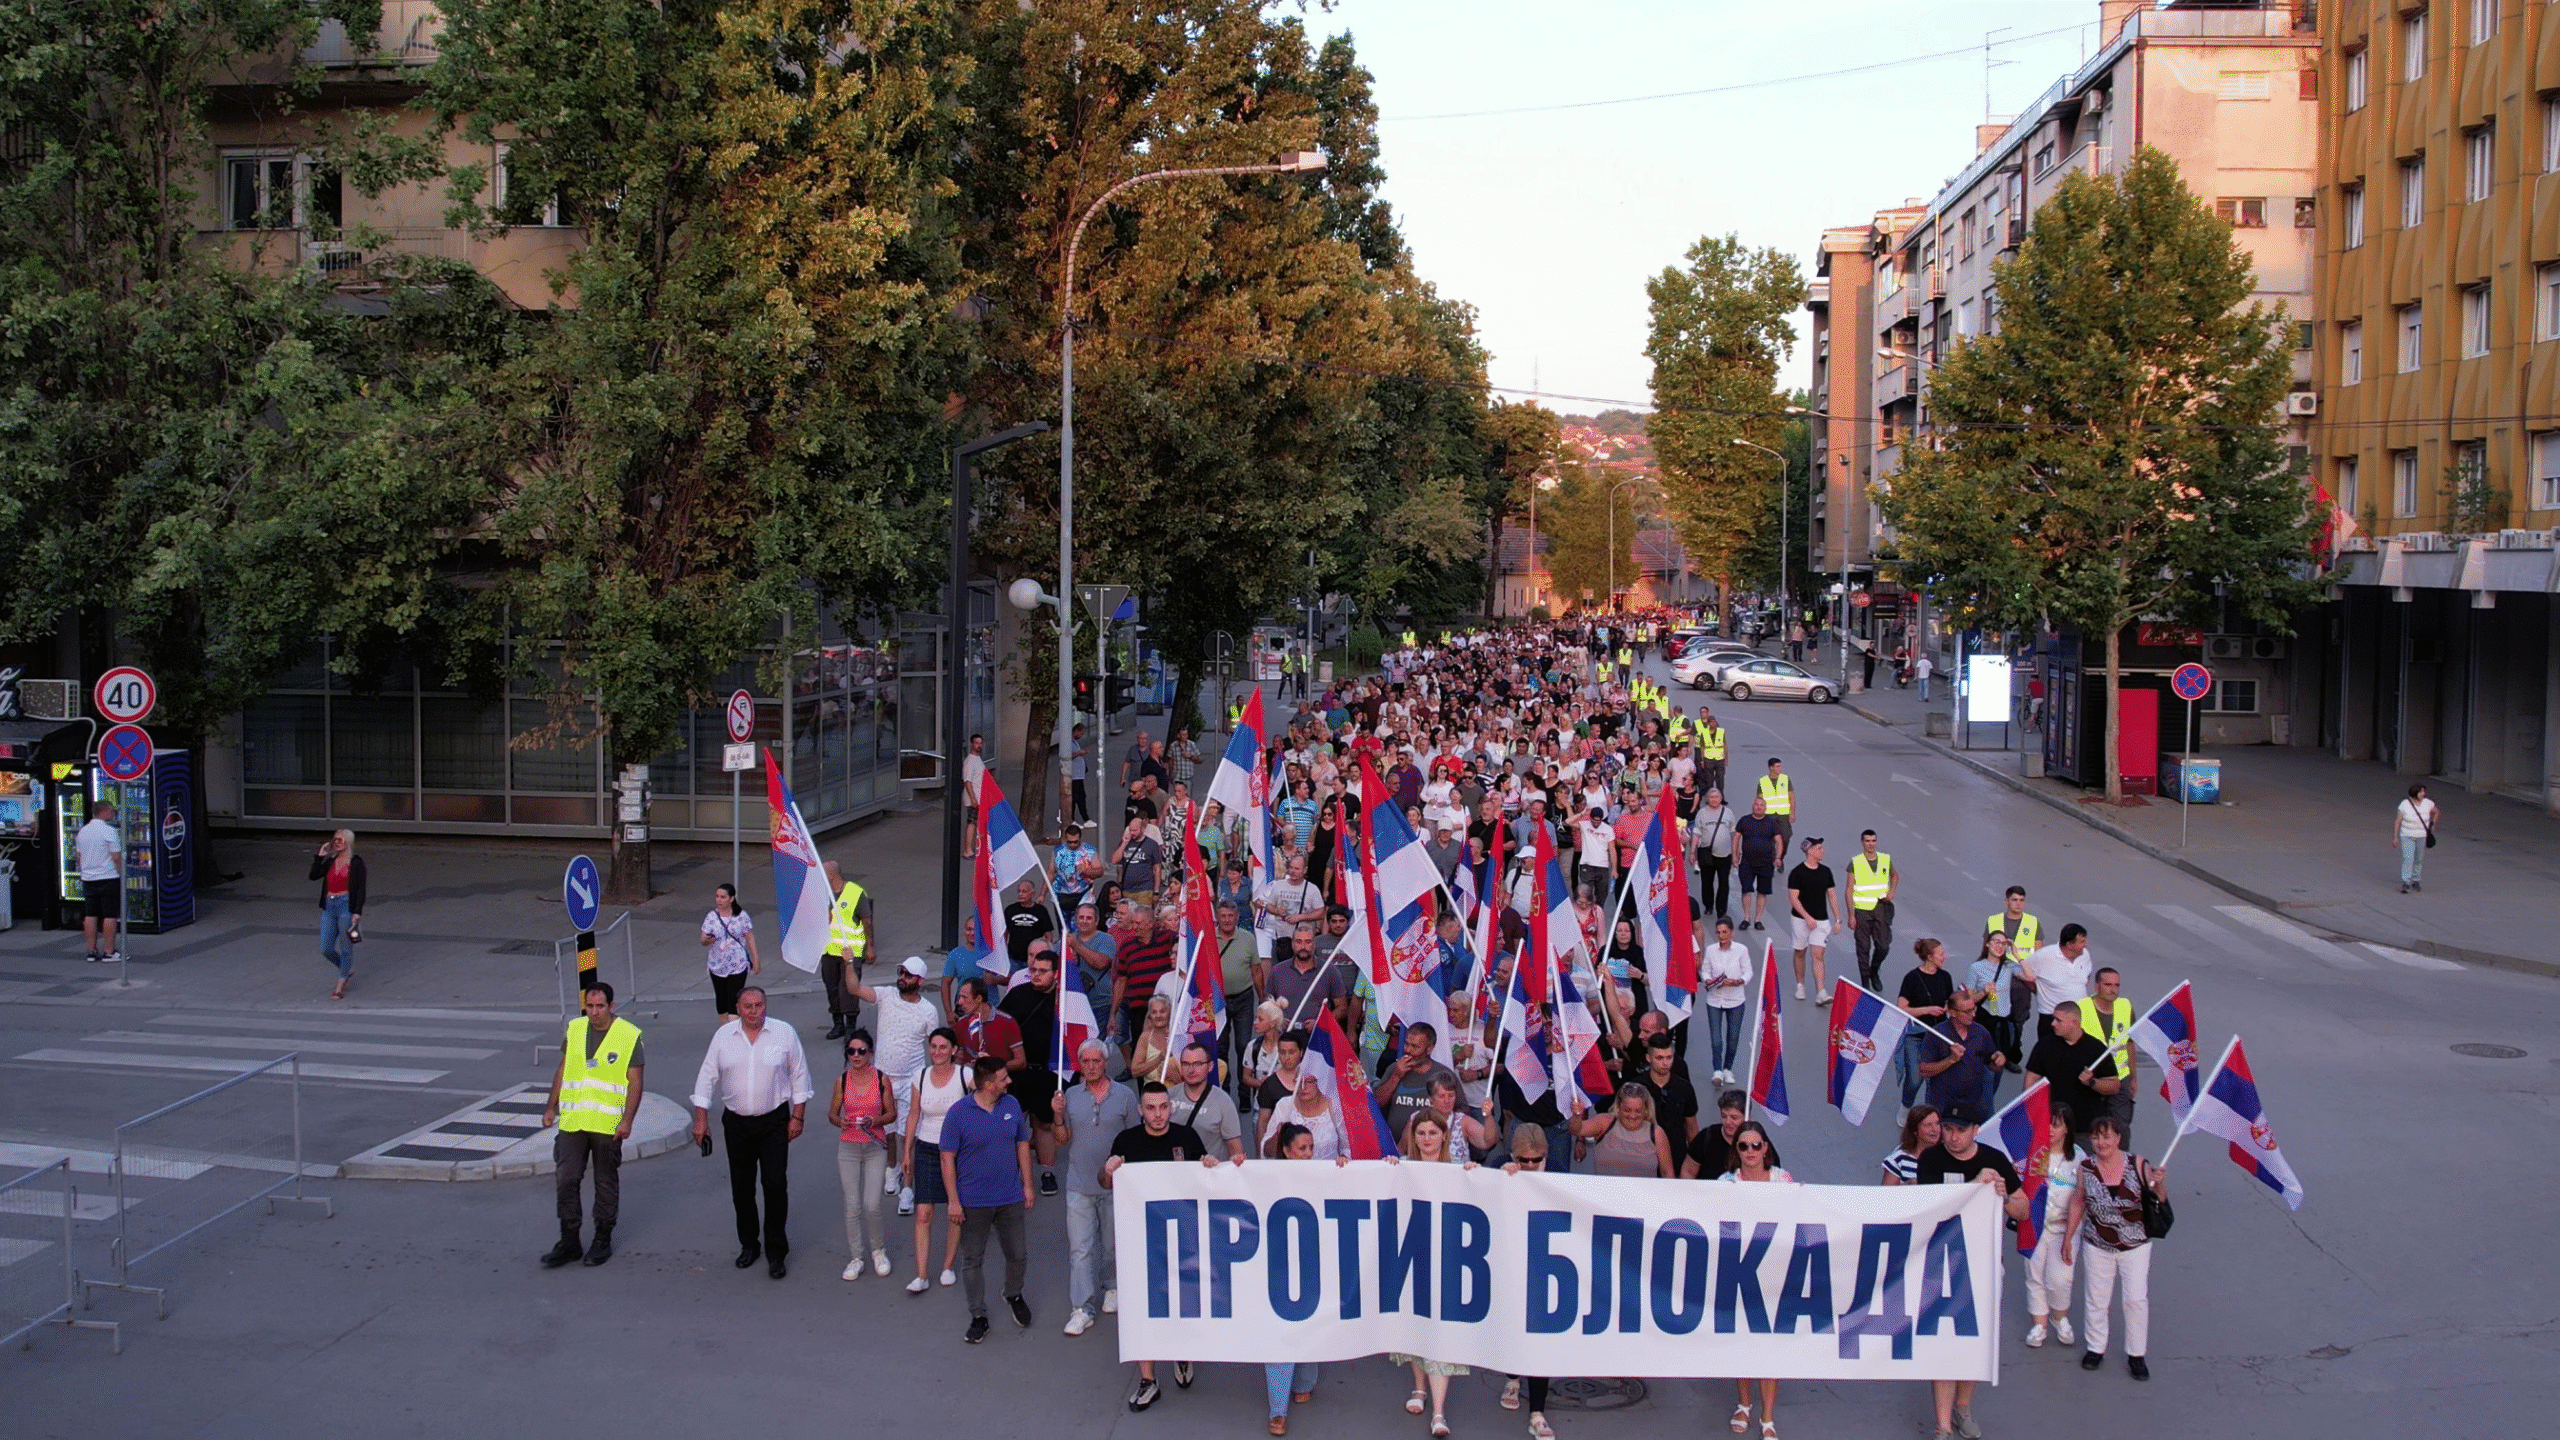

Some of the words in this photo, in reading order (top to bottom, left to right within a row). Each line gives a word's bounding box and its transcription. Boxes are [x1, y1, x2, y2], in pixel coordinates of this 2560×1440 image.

[107, 681, 142, 709] 40
[1395, 1095, 1413, 1107] AIR
[1416, 1097, 1433, 1107] MA
[1145, 1197, 1491, 1323] ПРОТИВ
[1525, 1210, 1980, 1361] БЛОКАДА
